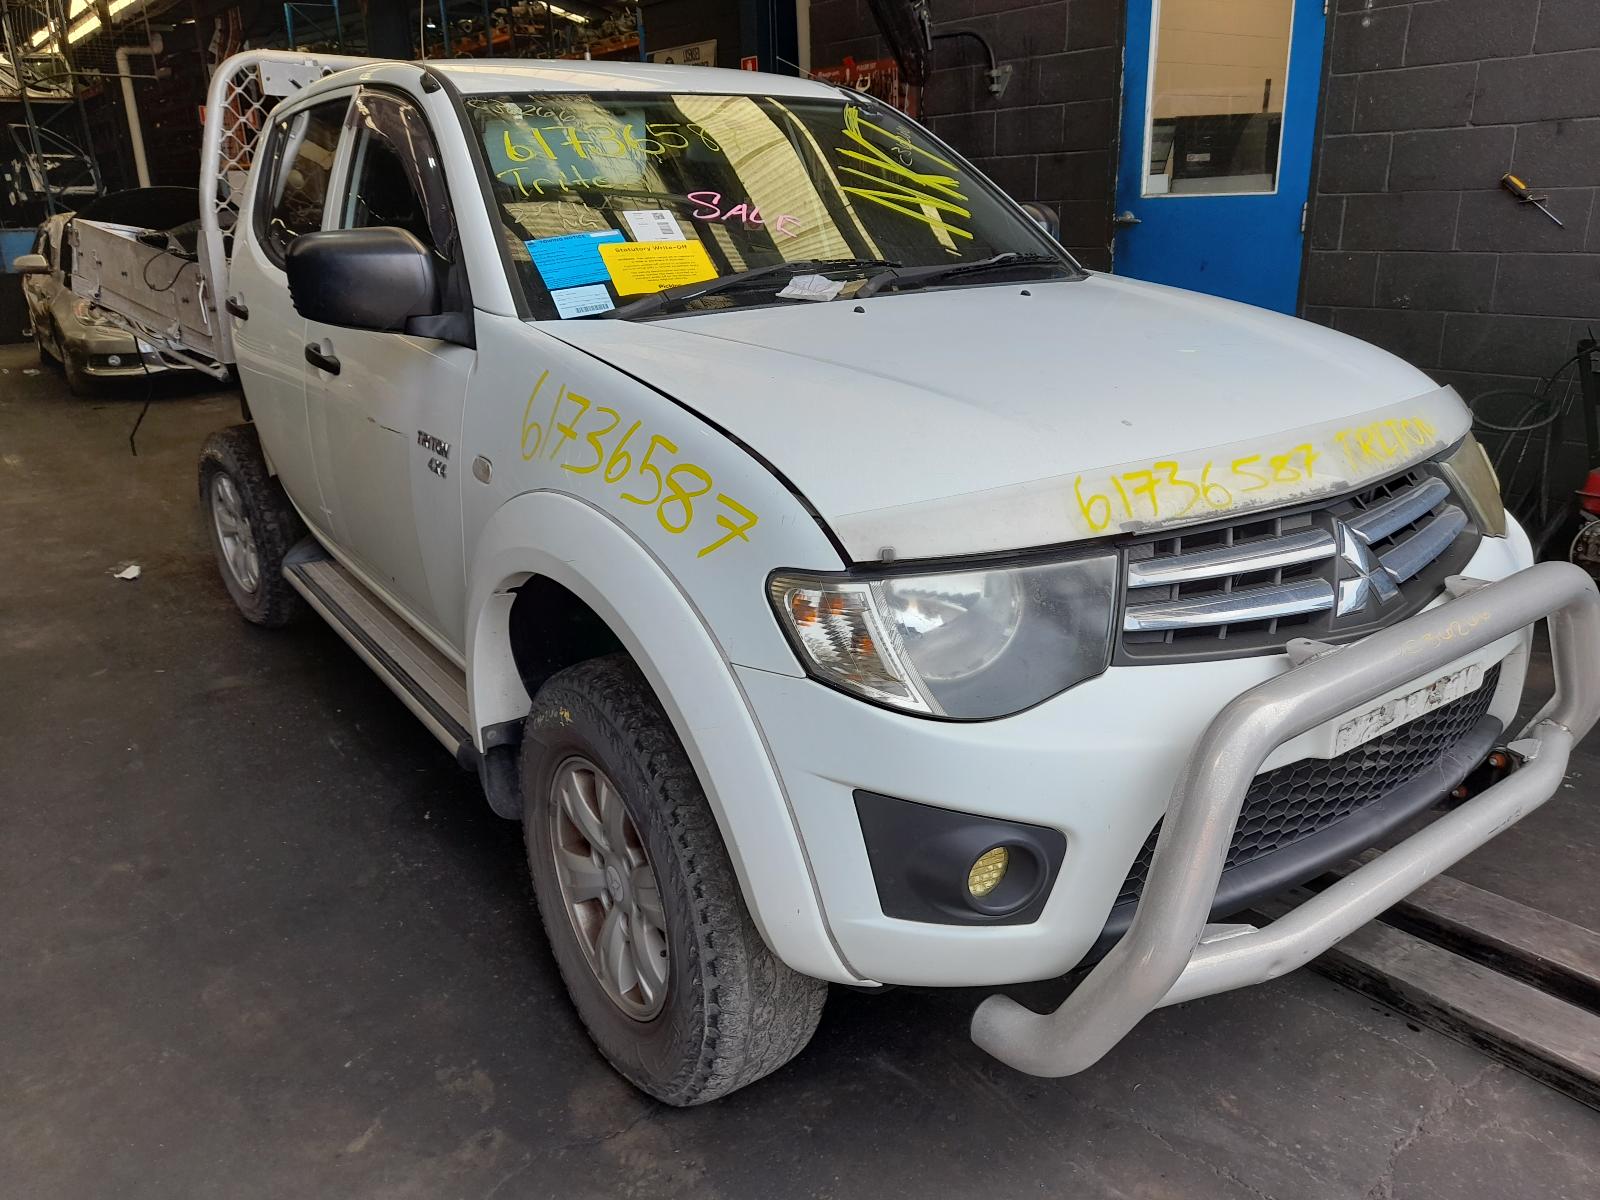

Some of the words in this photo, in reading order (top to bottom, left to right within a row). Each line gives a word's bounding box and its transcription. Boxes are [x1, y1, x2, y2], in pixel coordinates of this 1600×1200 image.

[687, 191, 801, 238] SALE
[614, 245, 651, 254] Statutory
[417, 429, 451, 460] TRITON
[521, 369, 759, 558] 61736587
